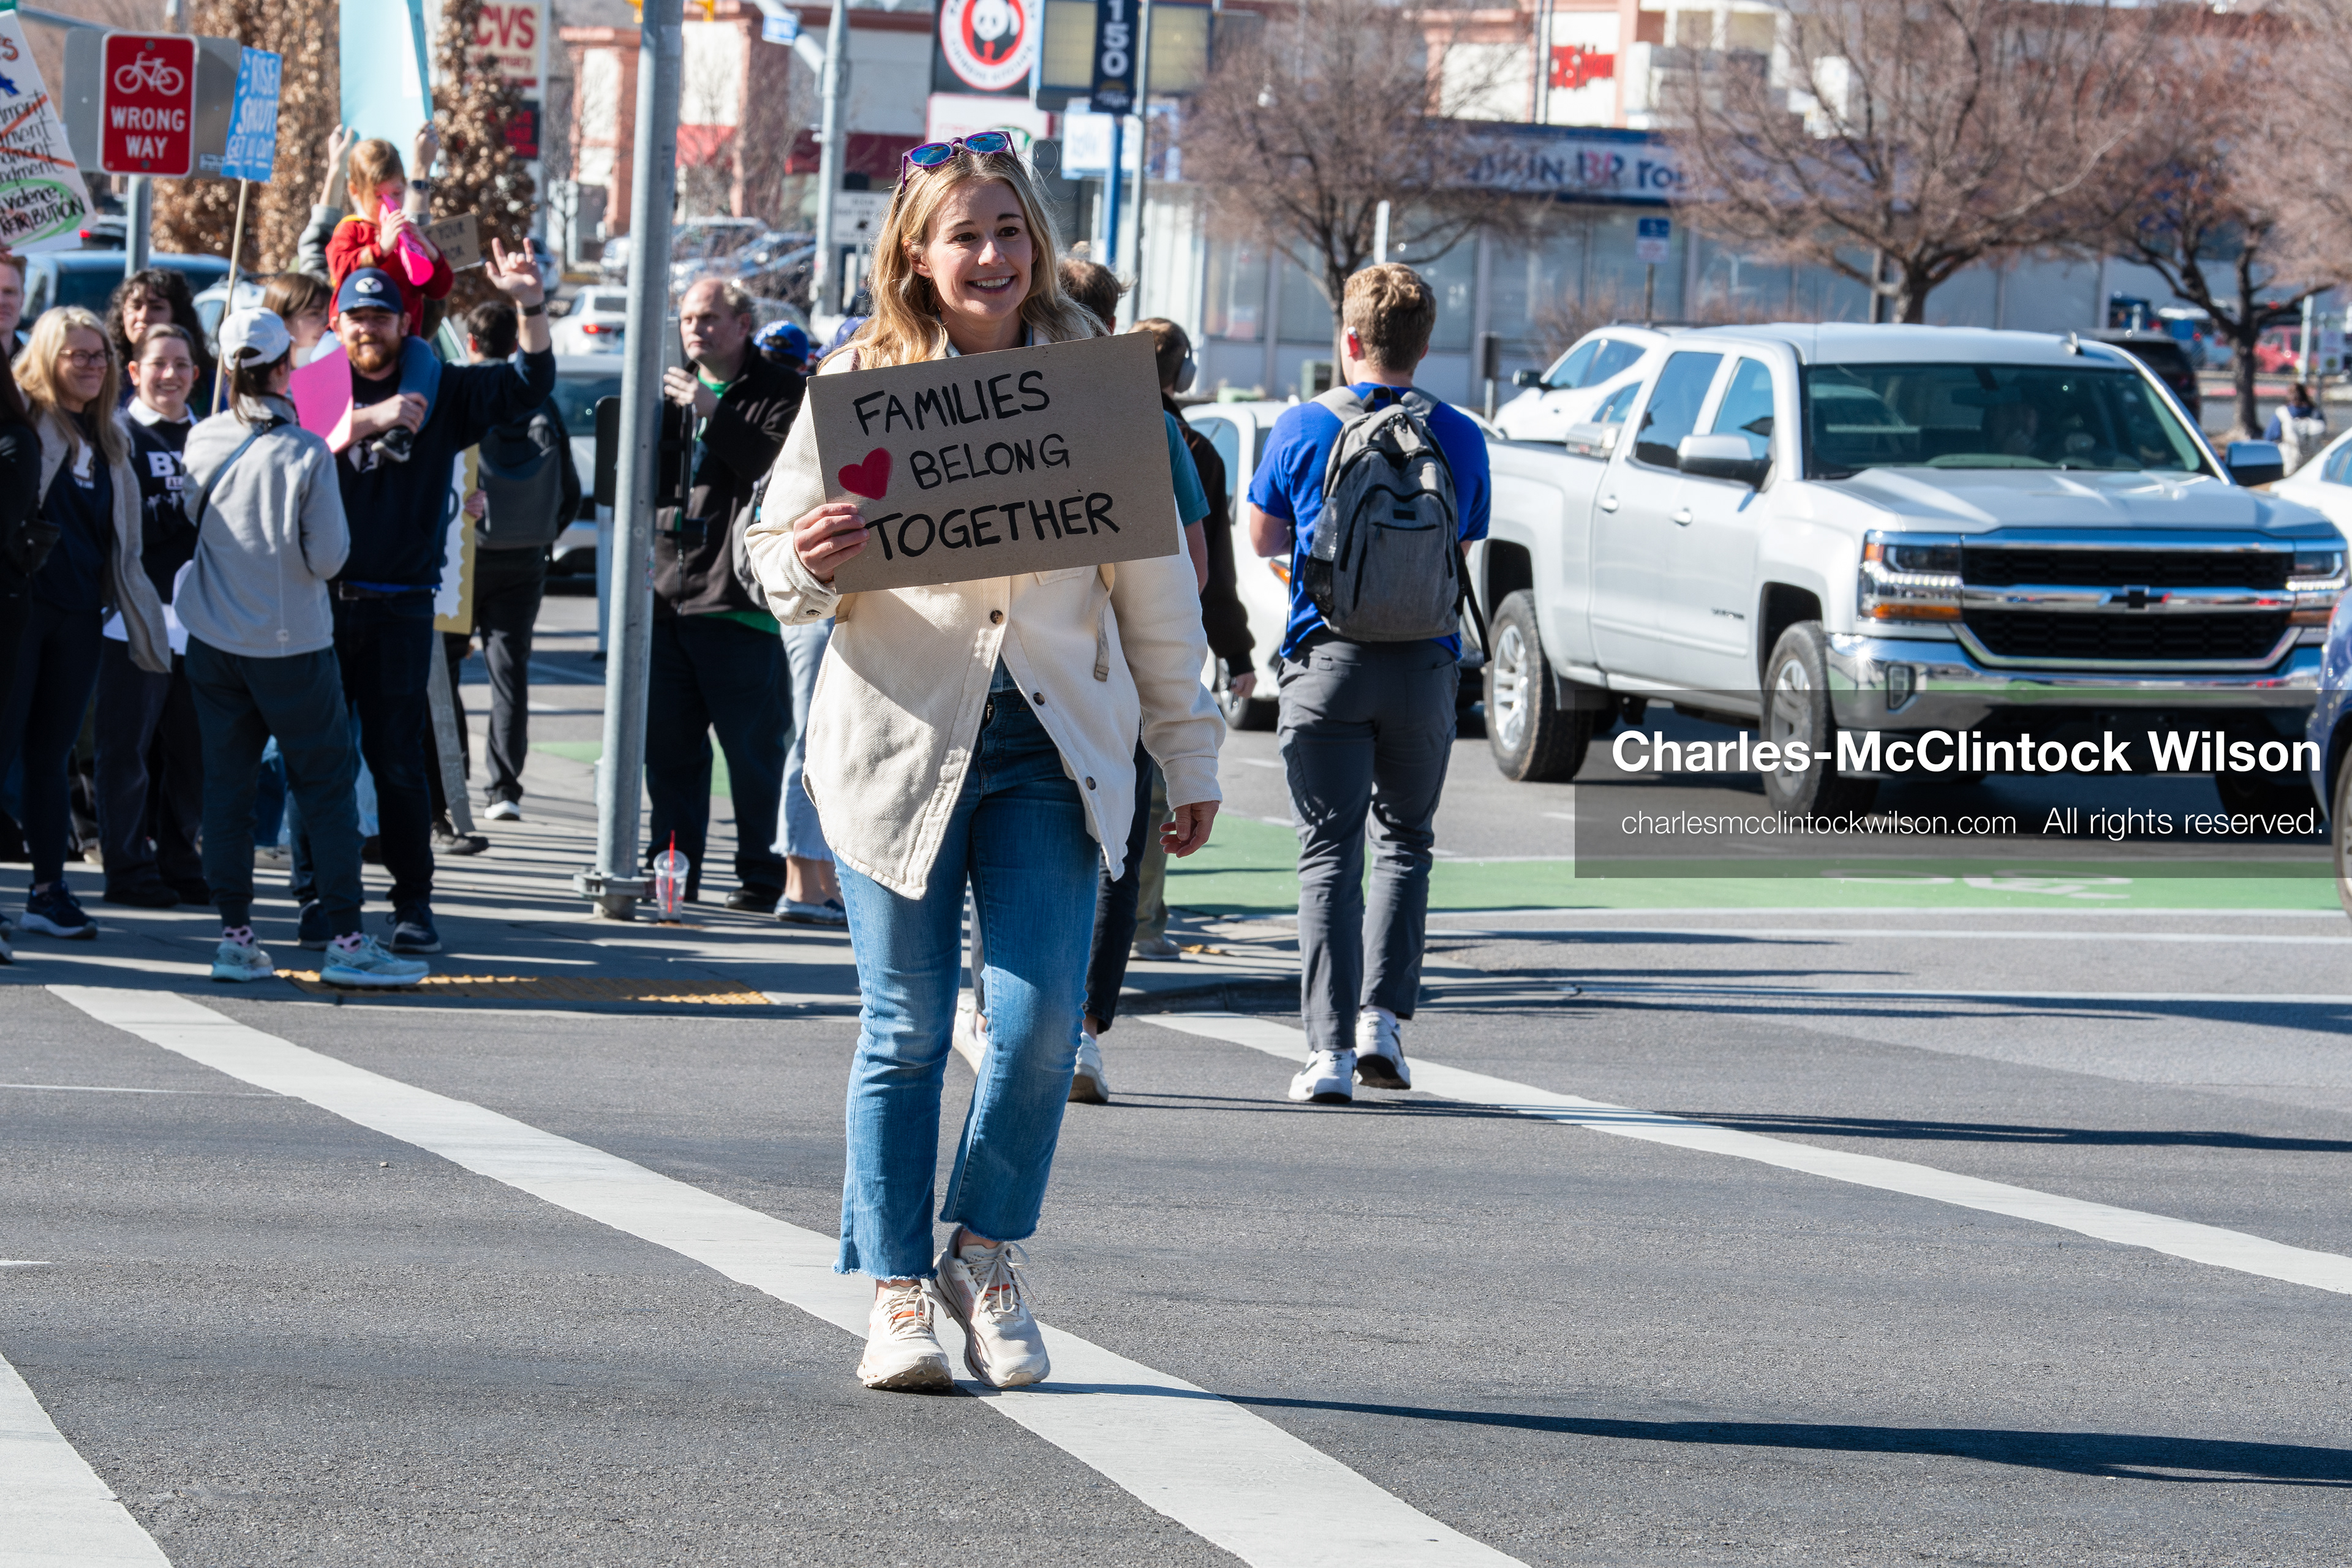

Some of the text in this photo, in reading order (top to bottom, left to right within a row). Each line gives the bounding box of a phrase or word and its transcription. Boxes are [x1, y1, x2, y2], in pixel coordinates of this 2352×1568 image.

[476, 6, 535, 49] CVS
[110, 105, 186, 132] WRONG
[125, 134, 168, 159] WAY
[853, 369, 1050, 435] FAMILIES
[910, 434, 1071, 489] BELONG
[864, 492, 1120, 560] TOGETHER
